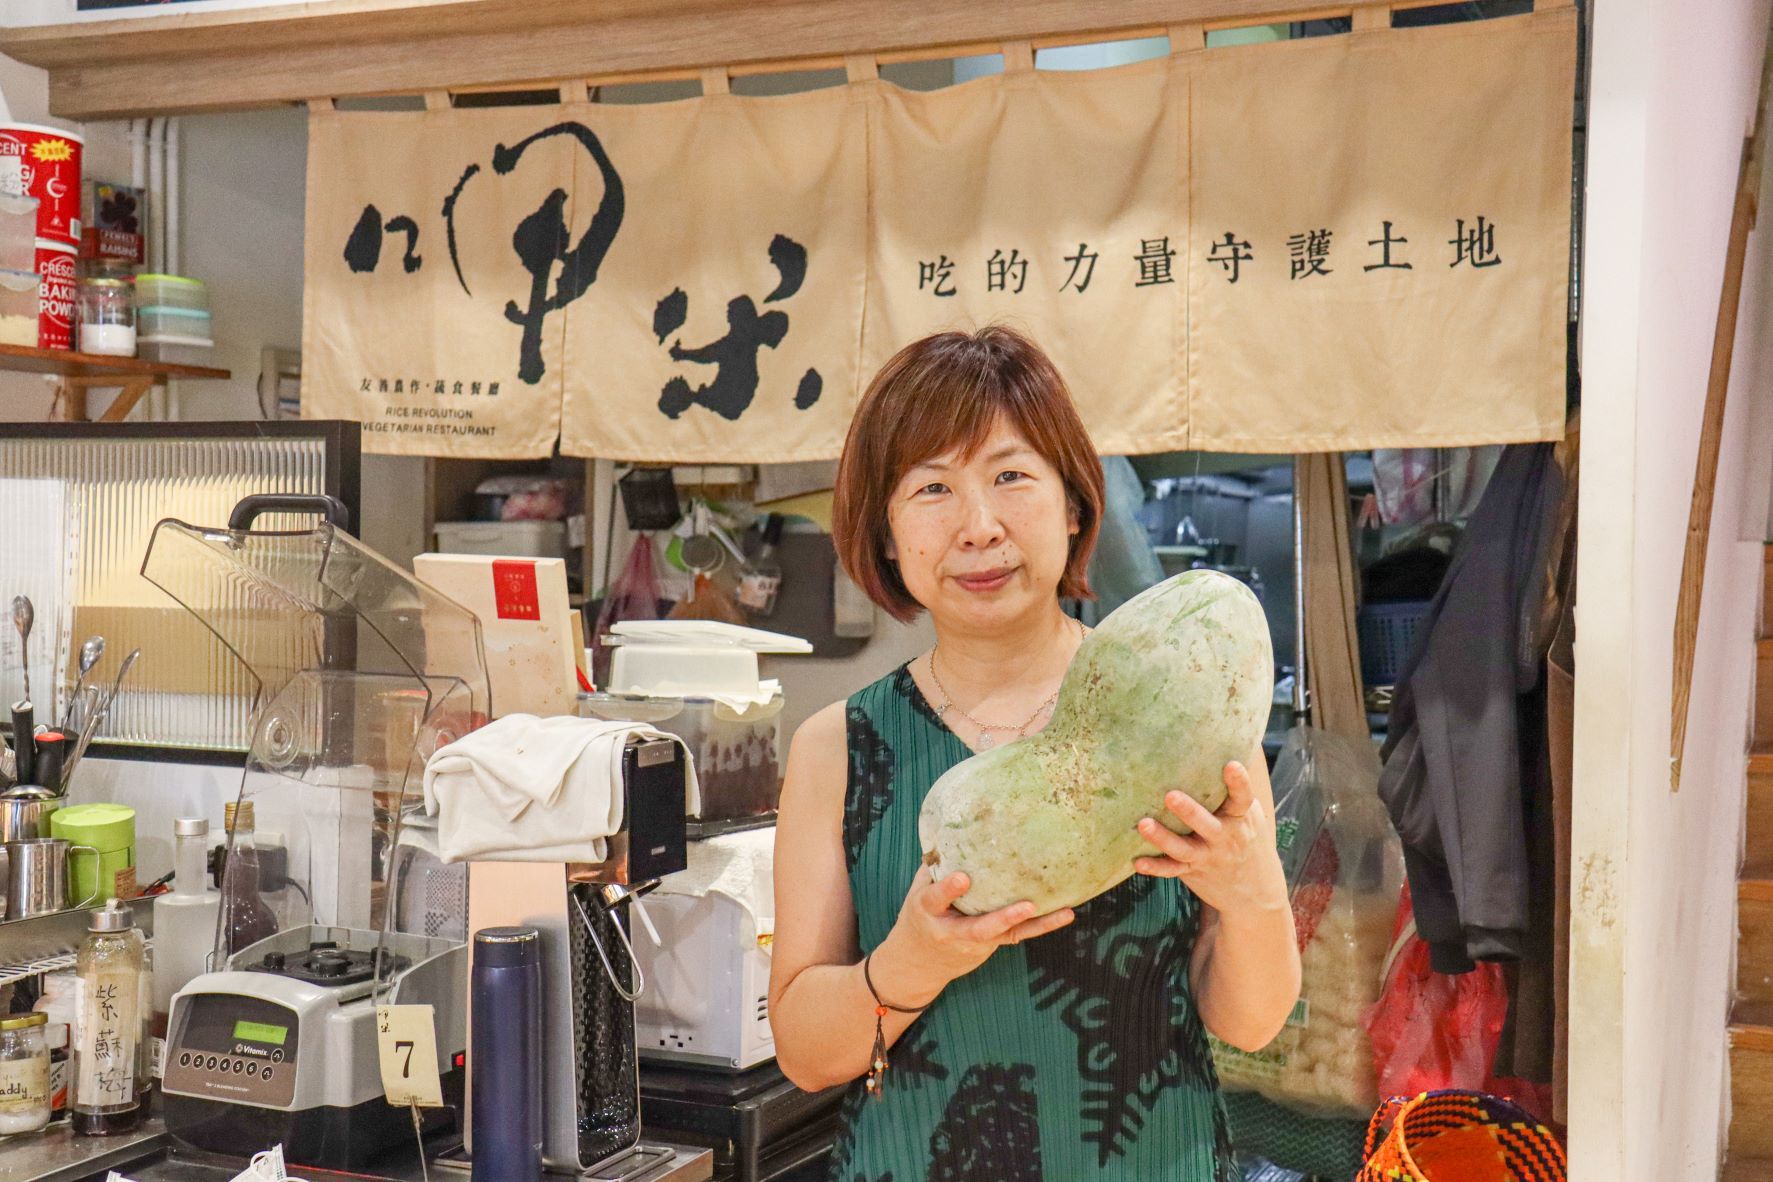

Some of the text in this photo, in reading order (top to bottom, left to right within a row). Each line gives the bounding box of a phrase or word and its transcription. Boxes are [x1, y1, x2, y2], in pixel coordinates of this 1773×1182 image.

[919, 216, 1502, 297] 吃的力量守護土地
[385, 407, 473, 419] RICE REVOLUTION
[362, 421, 496, 436] VEGETARIAN RESTAURANT
[243, 1045, 267, 1056] Vitamix
[395, 1041, 415, 1078] 7
